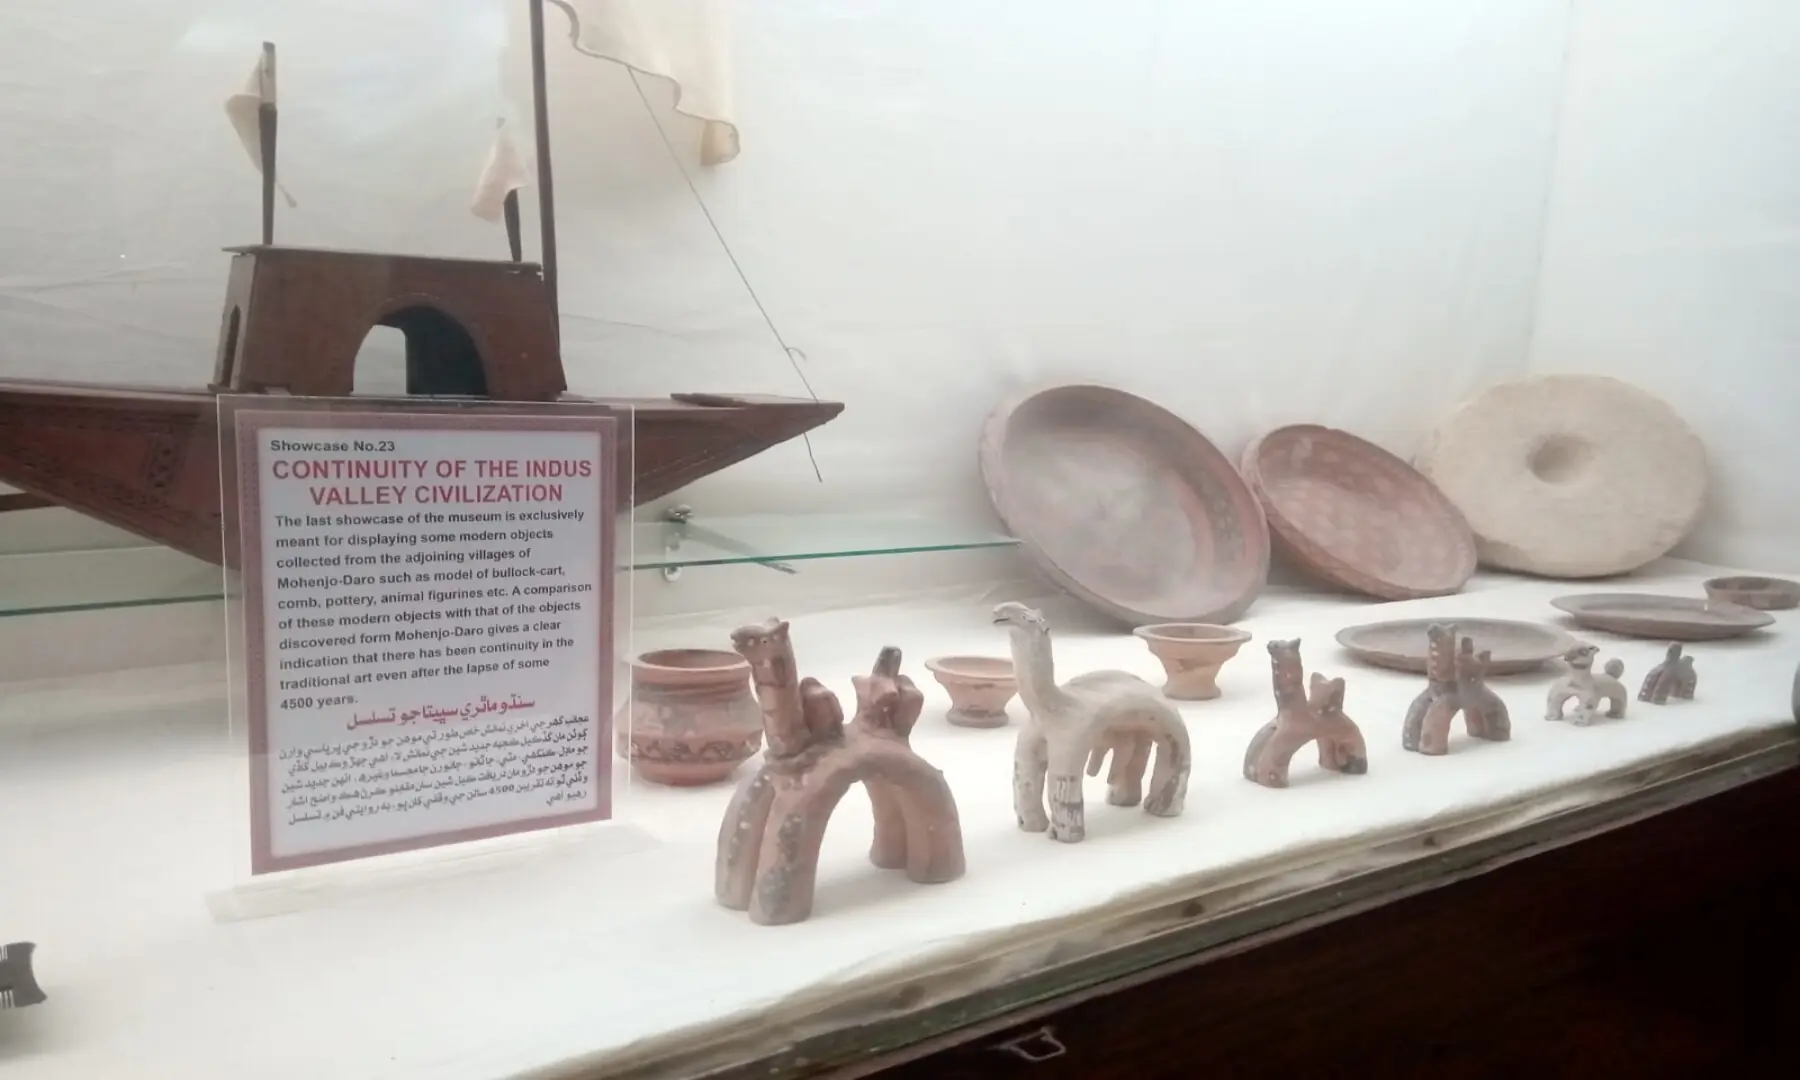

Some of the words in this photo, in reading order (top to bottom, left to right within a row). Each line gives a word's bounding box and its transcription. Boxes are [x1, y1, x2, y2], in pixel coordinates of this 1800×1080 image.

[270, 440, 349, 452] Showcase
[353, 440, 395, 452] No.23
[272, 459, 428, 479] CONTINUITY
[436, 460, 467, 478] OF
[474, 460, 519, 478] THE
[526, 459, 592, 478] INDUS
[310, 486, 407, 505] VALLEY
[414, 484, 562, 504] CIVILIZATION
[276, 515, 301, 527] The
[306, 515, 331, 526] last
[336, 514, 404, 525] showcase
[407, 512, 420, 524] of
[424, 512, 444, 523] the
[448, 513, 501, 523] museum
[505, 511, 516, 521] is
[519, 509, 584, 523] exclusively
[276, 535, 319, 548] meant
[324, 535, 343, 546] for
[347, 533, 417, 547] displaying
[420, 533, 456, 543] some
[459, 530, 506, 542] modern
[510, 529, 553, 542] objects
[276, 555, 341, 569] collected
[344, 554, 376, 565] from
[380, 553, 401, 564] the
[405, 551, 464, 565] adjoining
[468, 549, 515, 562] villages
[518, 548, 531, 558] of
[277, 574, 375, 589] Mohenjo-Daro
[379, 573, 412, 584] such
[415, 573, 430, 582] as
[434, 568, 473, 581] model
[476, 568, 488, 579] of
[492, 566, 565, 578] bullock-cart,
[278, 597, 321, 609] comb,
[326, 596, 377, 609] pottery,
[381, 591, 424, 604] animal
[428, 588, 483, 602] figurines
[487, 587, 508, 597] etc.
[511, 586, 521, 596] A
[523, 583, 592, 596] comparison
[278, 618, 292, 630] of
[296, 616, 335, 629] these
[339, 613, 390, 626] modern
[394, 610, 441, 624] objects
[445, 606, 471, 619] with
[475, 606, 499, 617] that
[502, 604, 514, 616] of
[517, 603, 536, 614] the
[539, 602, 581, 613] objects
[279, 634, 356, 650] discovered
[360, 633, 391, 644] form
[395, 625, 484, 641] Mohenjo-Daro
[487, 624, 520, 637] gives
[522, 623, 530, 632] a
[533, 620, 561, 632] clear
[279, 655, 348, 670] indication
[352, 652, 378, 664] that
[382, 650, 415, 662] there
[419, 648, 441, 659] has
[446, 645, 476, 656] been
[480, 641, 539, 653] continuity
[542, 638, 553, 648] in
[556, 637, 574, 647] the
[280, 674, 350, 690] traditional
[354, 673, 372, 684] art
[376, 671, 407, 682] even
[411, 667, 440, 679] after
[443, 665, 463, 676] the
[466, 662, 499, 676] lapse
[503, 660, 515, 670] of
[518, 658, 550, 669] some
[280, 696, 313, 710] 4500
[317, 694, 358, 709] years.
[346, 707, 395, 730] تسلسل
